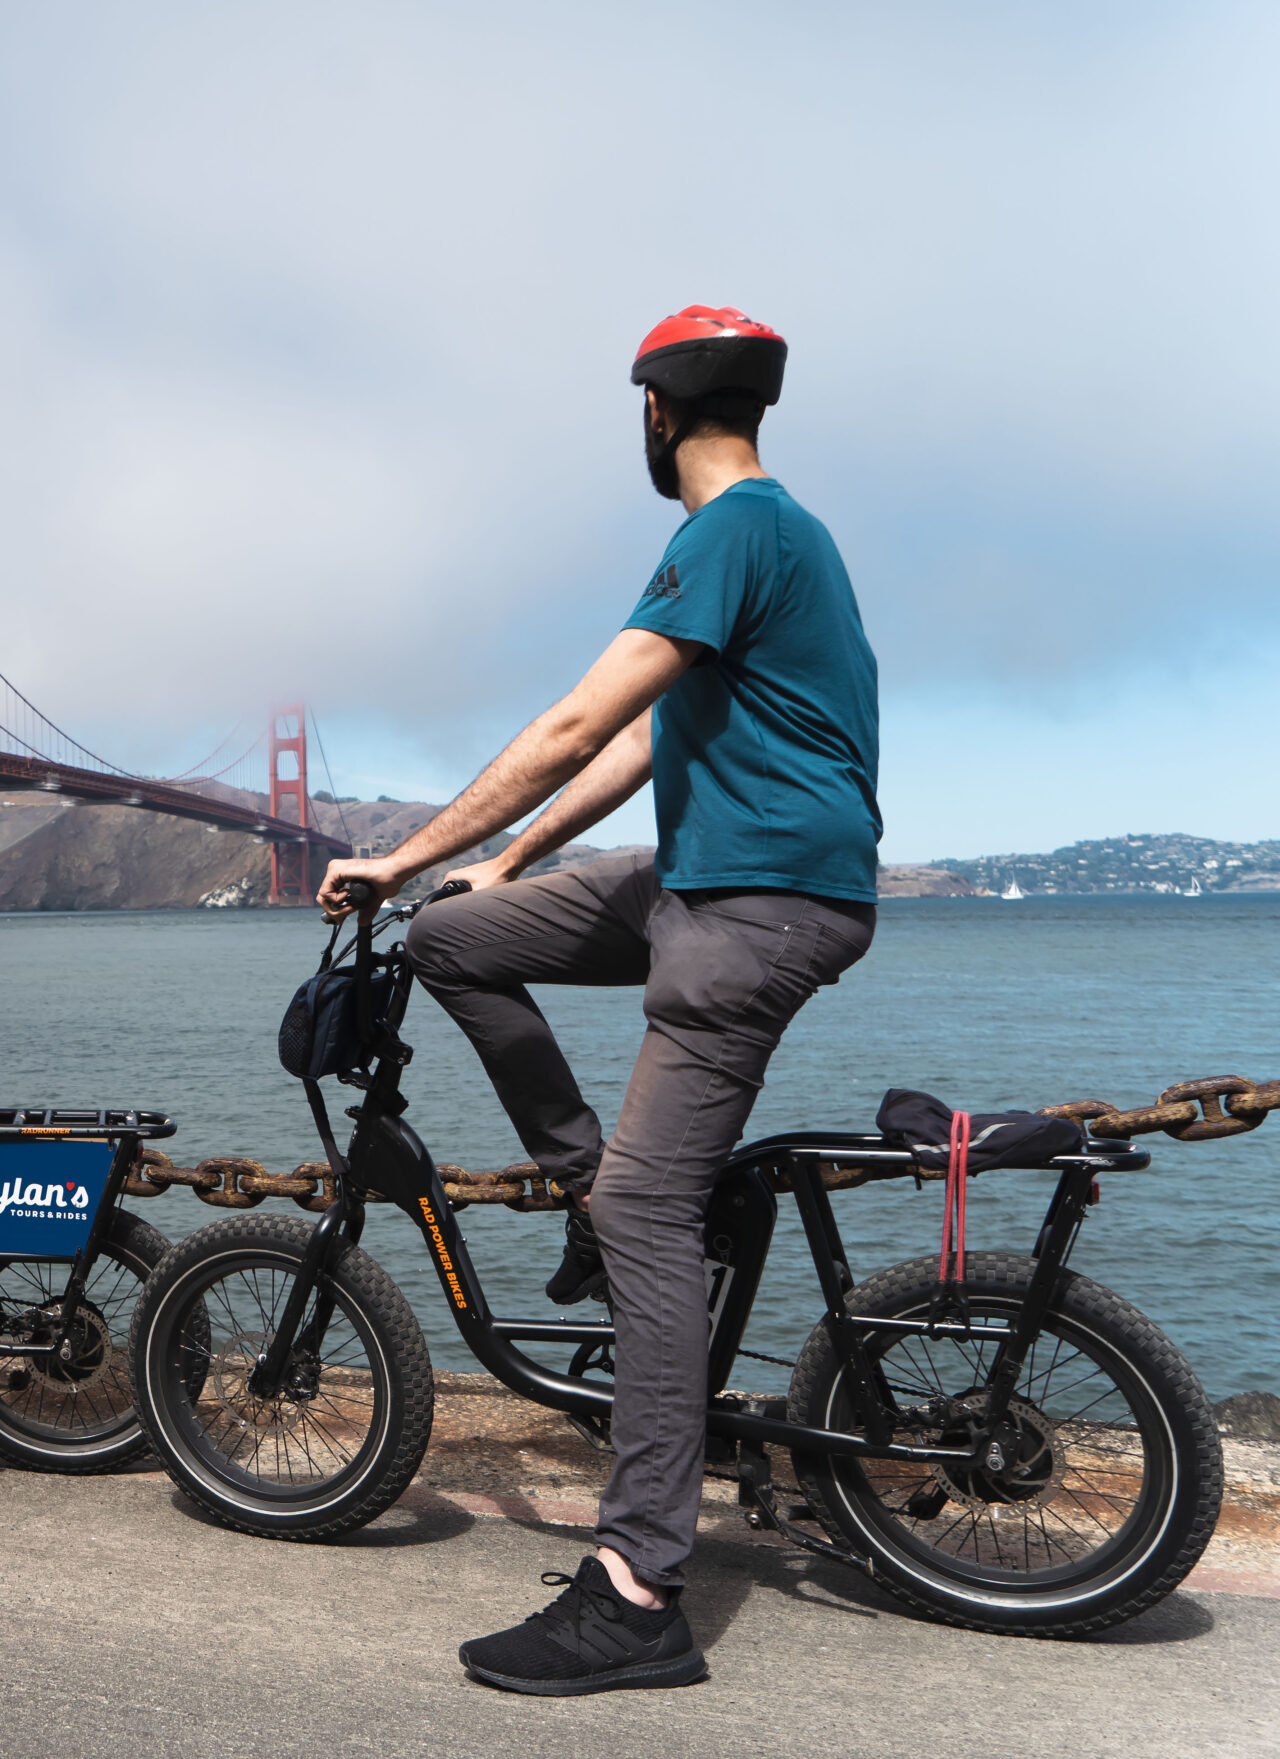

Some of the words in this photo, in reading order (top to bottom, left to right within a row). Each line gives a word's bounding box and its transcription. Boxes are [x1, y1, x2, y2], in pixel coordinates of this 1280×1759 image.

[10, 1209, 46, 1218] TOURS
[47, 1211, 55, 1219] &
[55, 1211, 88, 1221] RIDES
[418, 1197, 436, 1224] RAD
[429, 1224, 453, 1271] POWER
[446, 1272, 468, 1310] BIKES
